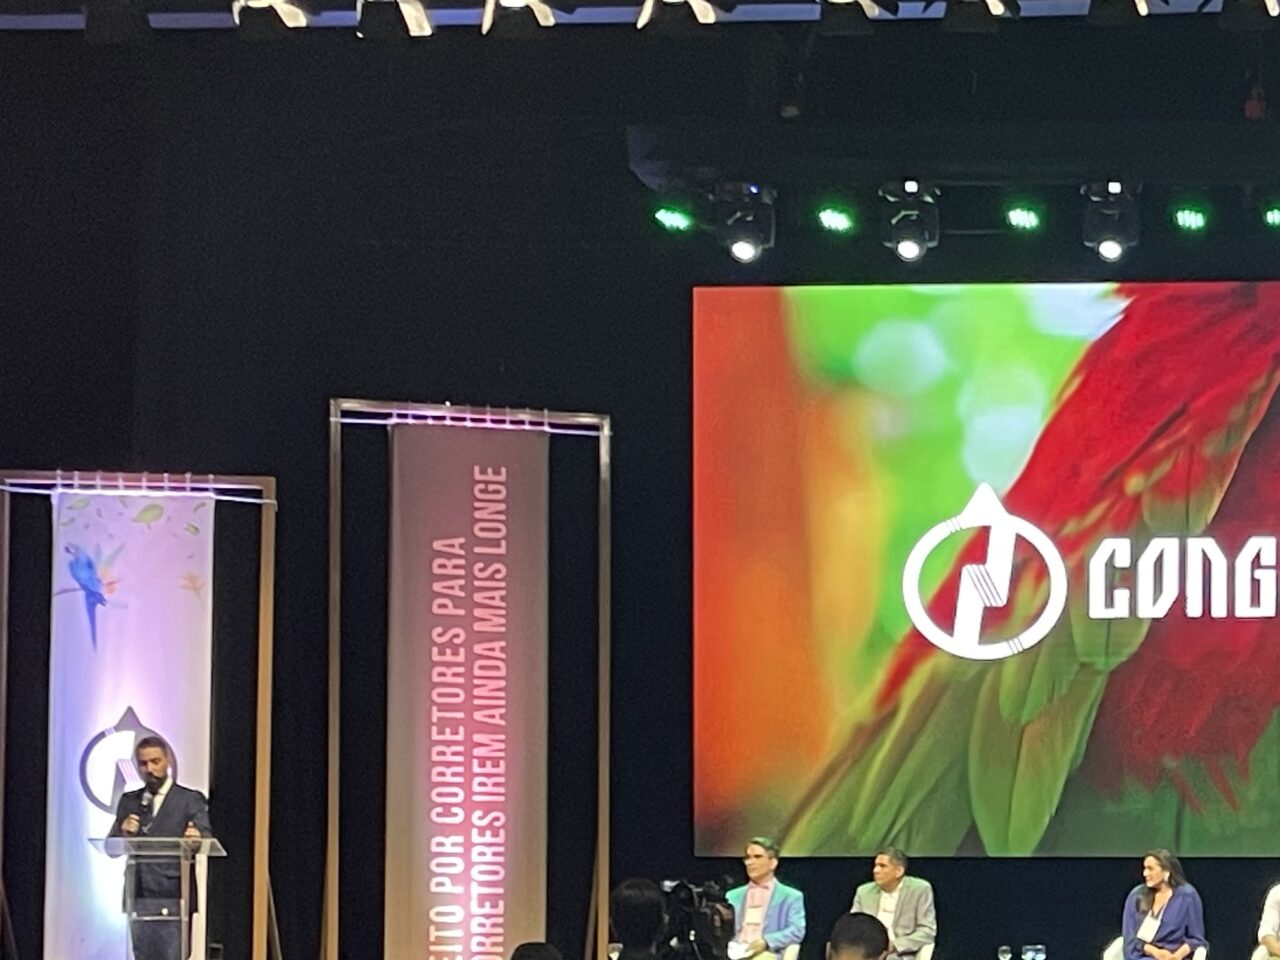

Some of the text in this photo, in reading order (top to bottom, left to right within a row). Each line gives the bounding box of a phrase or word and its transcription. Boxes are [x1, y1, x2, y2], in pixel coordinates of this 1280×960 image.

[472, 464, 508, 555] LONGE
[431, 536, 466, 616] PARA
[472, 561, 507, 633] MAIS
[472, 640, 507, 726] AINDA
[430, 626, 466, 824] CORRETORES
[471, 732, 507, 802] IREM
[429, 835, 465, 894] POR
